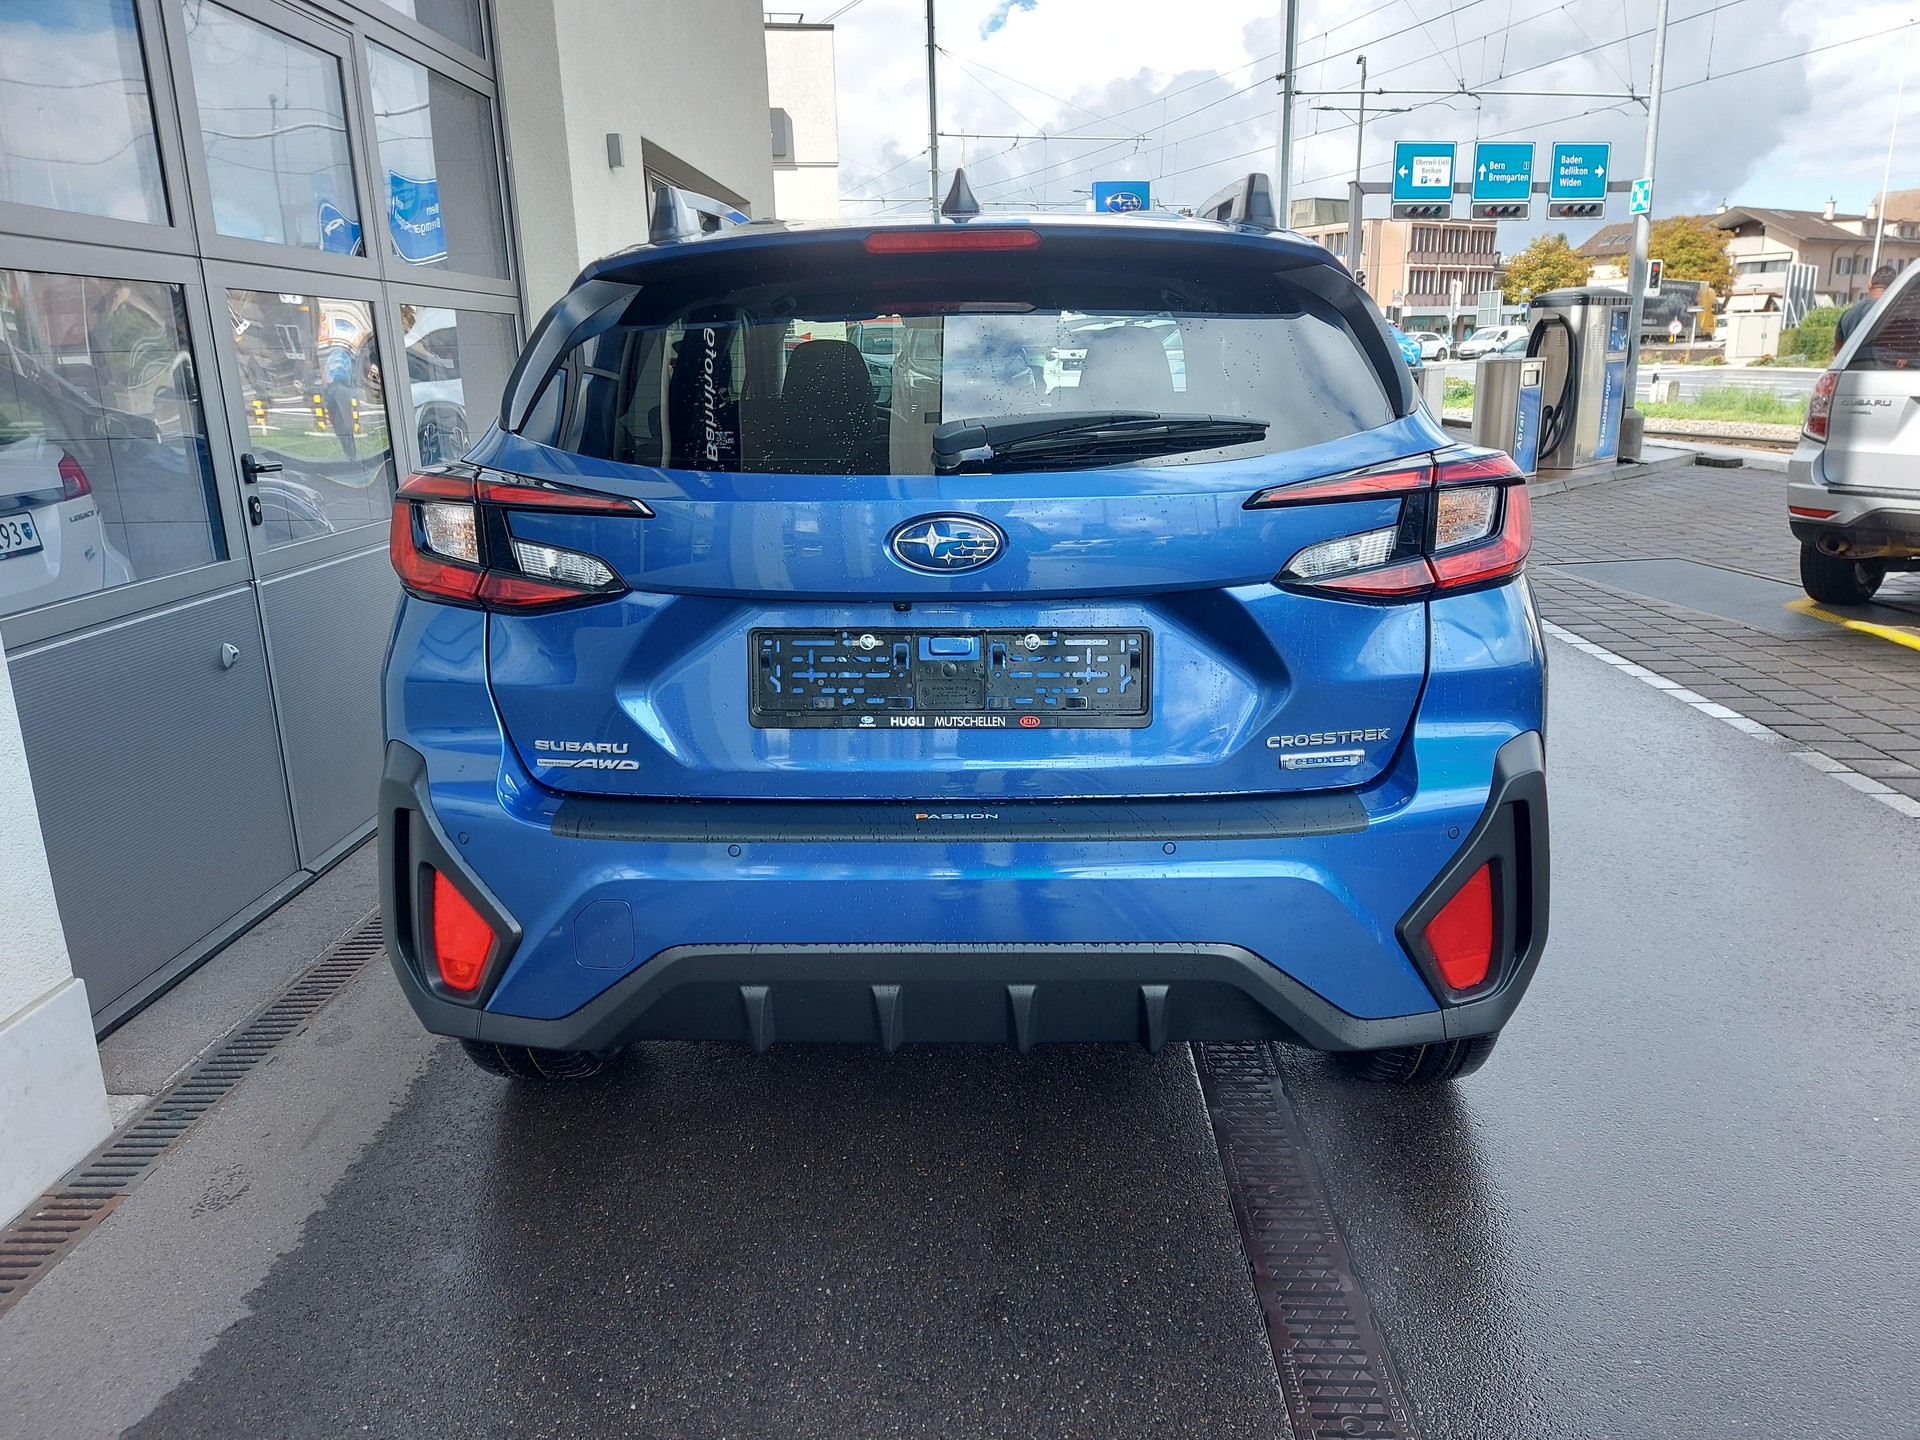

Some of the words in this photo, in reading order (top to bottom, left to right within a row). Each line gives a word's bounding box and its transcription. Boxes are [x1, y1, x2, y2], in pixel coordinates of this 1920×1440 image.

[1489, 161, 1506, 170] Bern
[1561, 155, 1583, 164] Baden
[1560, 166, 1588, 175] Bellikon
[1488, 172, 1529, 184] Bremgarten
[1559, 177, 1582, 187] Widen
[1599, 372, 1612, 448] Staubsauger
[1516, 411, 1526, 451] Abfall
[69, 510, 95, 523] LEGACY
[0, 521, 22, 549] 93
[934, 716, 1006, 727] MUTSCHELLEN
[1266, 728, 1391, 749] CROSSTREK
[534, 739, 629, 754] SUBARU
[573, 758, 640, 771] AWD
